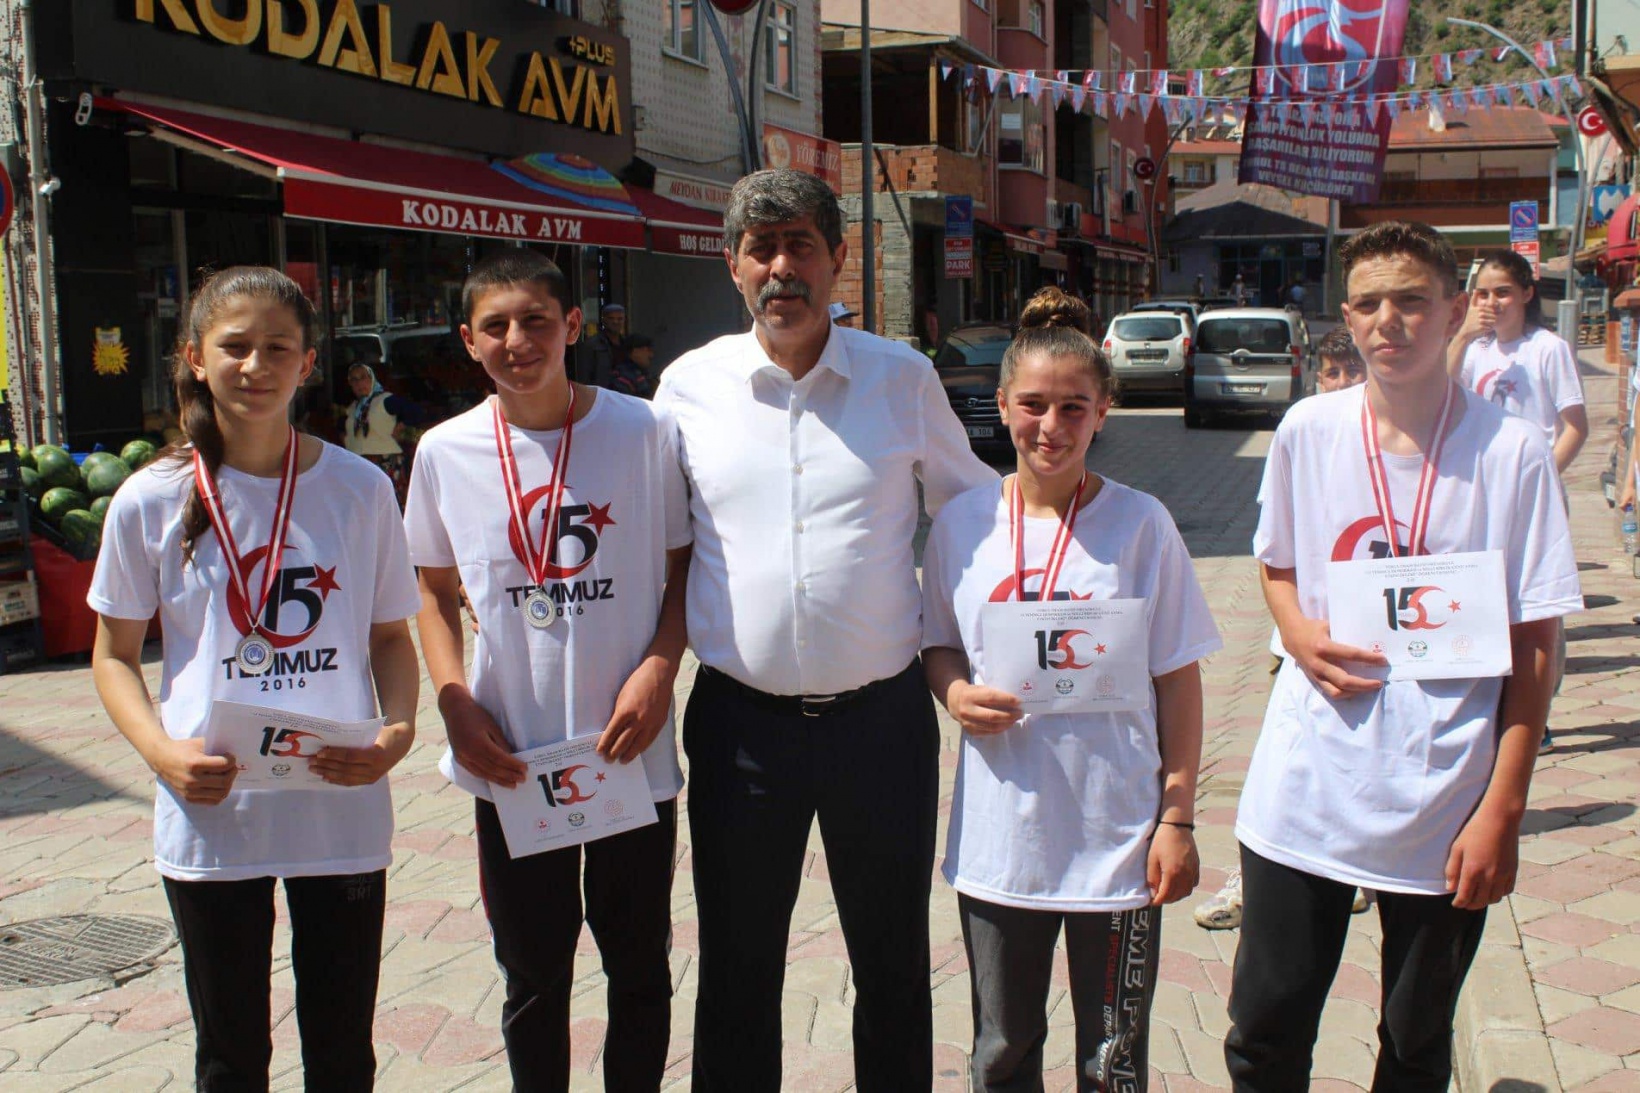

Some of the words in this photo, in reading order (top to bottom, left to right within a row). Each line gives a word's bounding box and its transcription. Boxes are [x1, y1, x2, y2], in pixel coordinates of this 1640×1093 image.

[518, 51, 622, 135] AVM
[1328, 129, 1380, 148] YOLUNDA
[402, 199, 528, 236] KODALAK
[538, 217, 582, 240] AVM
[679, 234, 697, 253] HOŞ
[699, 235, 725, 253] GELDİ
[946, 260, 971, 270] PARK
[264, 566, 323, 634] 15
[556, 605, 584, 617] 016
[222, 647, 339, 680] TMMUZ
[260, 677, 306, 692] 2016
